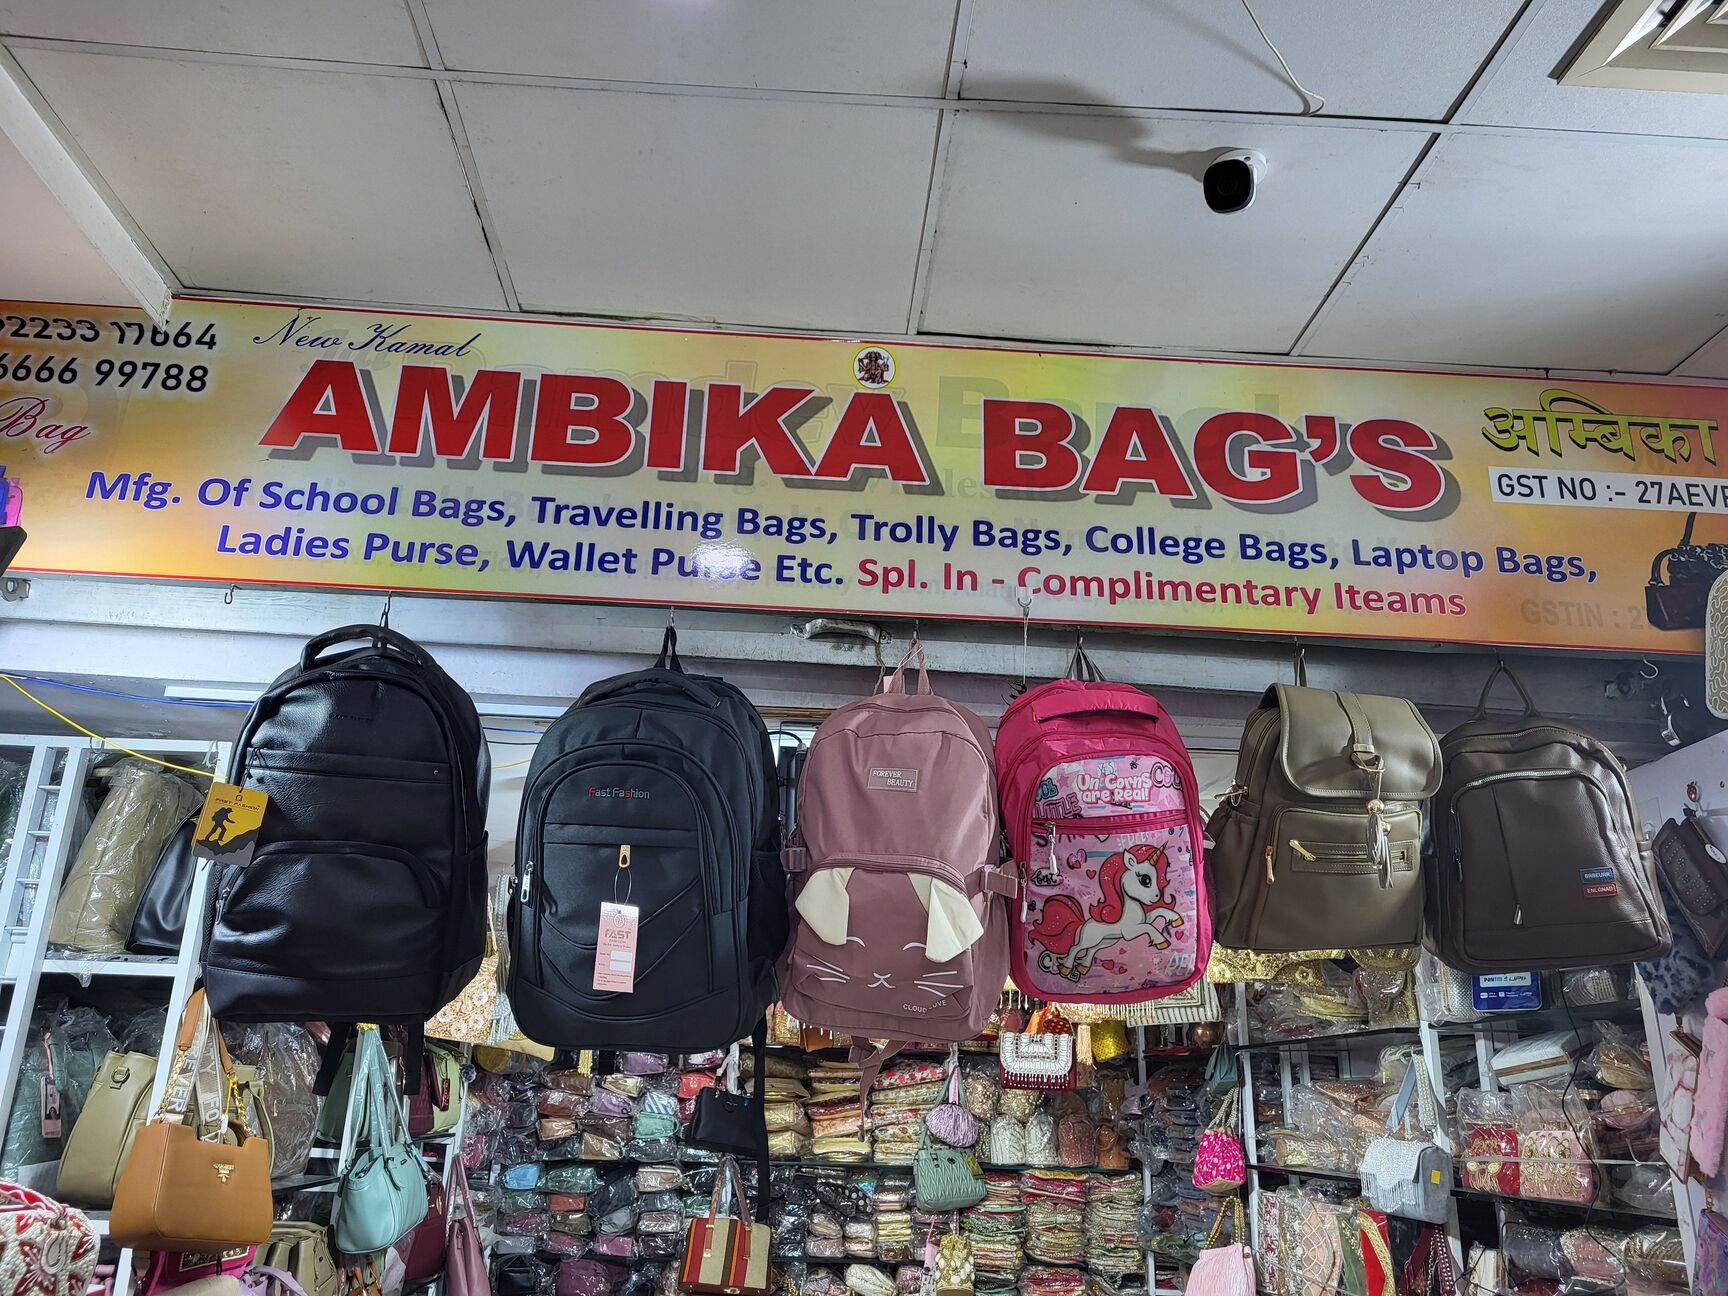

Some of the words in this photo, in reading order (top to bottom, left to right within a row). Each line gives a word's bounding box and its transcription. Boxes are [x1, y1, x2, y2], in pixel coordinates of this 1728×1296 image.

[0, 315, 100, 343] 2233
[253, 316, 343, 348] New
[348, 322, 481, 357] Kamal
[95, 358, 209, 393] 99788
[258, 359, 930, 487] AMBIKA
[982, 397, 1446, 512] BAG'S
[1481, 388, 1718, 466] अम्बिका
[1498, 472, 1549, 499] GST
[1559, 476, 1598, 502] NO
[85, 471, 182, 511] Mfg.
[197, 476, 254, 508] Of
[258, 480, 399, 516] School
[411, 489, 518, 529] Bags,
[530, 495, 725, 539] Travelling
[736, 506, 838, 545] Bags,
[851, 513, 960, 552] Trolly
[972, 519, 1071, 558] Bags,
[1085, 525, 1227, 564] College
[1239, 532, 1340, 570] Bags,
[1352, 538, 1485, 578] Laptop
[1496, 546, 1597, 583] Bags,
[217, 524, 350, 561] Ladies
[363, 531, 490, 573] Purse,
[506, 540, 638, 576] Wallet
[651, 548, 762, 582] Pue
[775, 554, 844, 586] Etc.
[857, 558, 928, 594] Spl.
[943, 562, 979, 592] In
[1017, 566, 1322, 615] Complimentary
[1335, 581, 1467, 617] Iteams
[872, 770, 902, 778] FOREVER
[887, 778, 914, 787] BEAUTY
[1082, 790, 1111, 802] are
[1113, 788, 1150, 802] Real!
[604, 929, 632, 940] FAST
[903, 1003, 928, 1014] CLOUD
